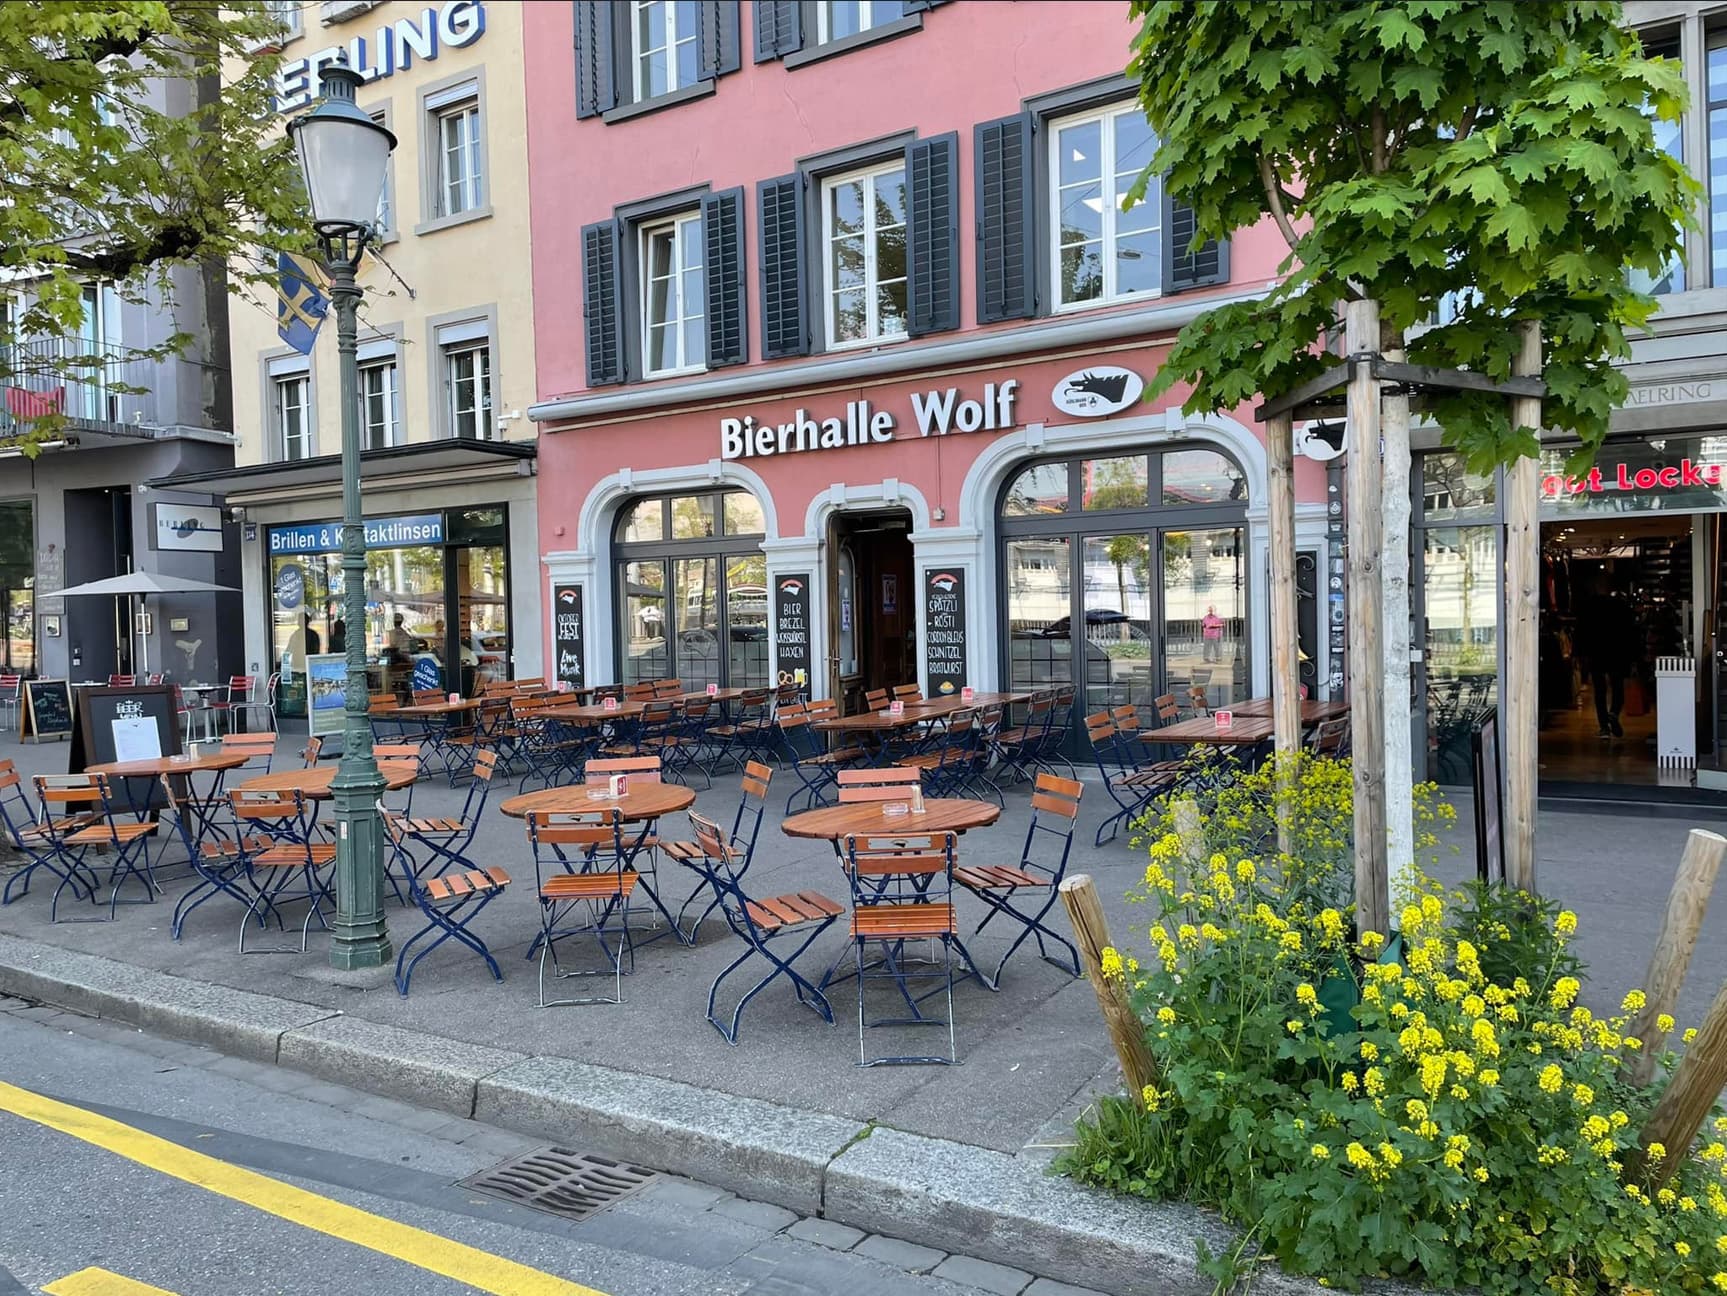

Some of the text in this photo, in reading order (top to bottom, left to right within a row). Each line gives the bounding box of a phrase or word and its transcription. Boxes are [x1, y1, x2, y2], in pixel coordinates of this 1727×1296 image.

[244, 1, 485, 120] ERLING
[720, 379, 1018, 459] Bierhalle Wolf
[1539, 466, 1604, 497] oot
[271, 522, 441, 549] Brillen & Ktaktlinsen
[783, 602, 802, 616] BIER
[559, 622, 580, 636] FEST
[779, 617, 806, 630] BREZEL
[561, 649, 578, 663] Live
[780, 646, 804, 658] HAXEN
[928, 646, 963, 659] SCHNITZEL
[928, 661, 964, 675] BRATWURST
